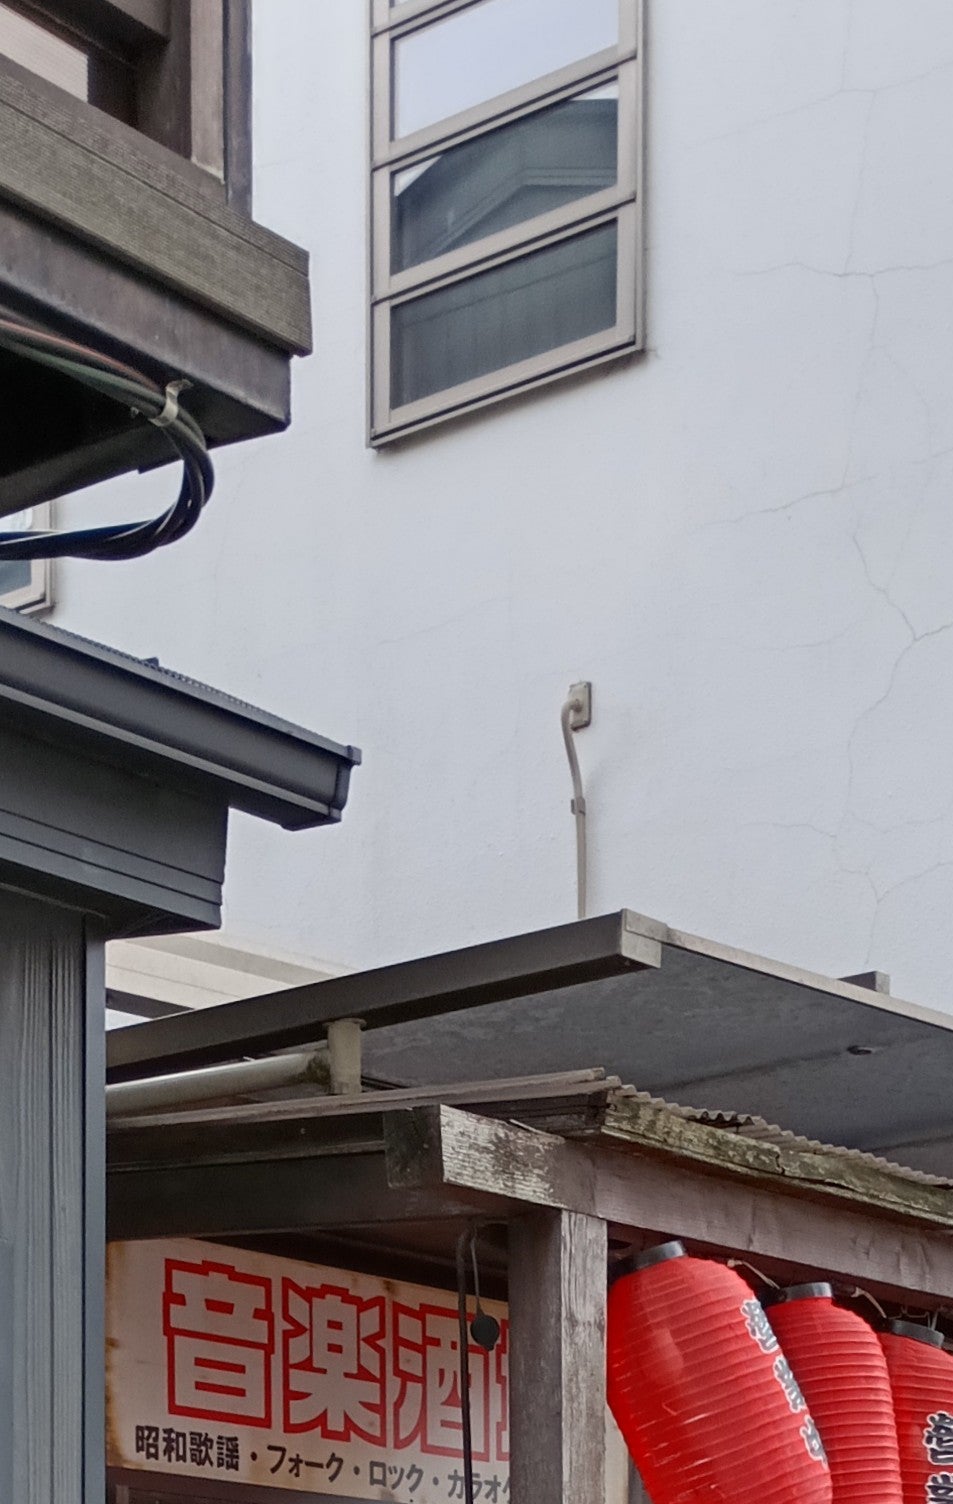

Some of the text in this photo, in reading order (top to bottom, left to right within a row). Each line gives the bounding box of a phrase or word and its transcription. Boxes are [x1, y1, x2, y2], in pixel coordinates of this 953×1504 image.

[163, 1257, 509, 1463] 音楽酒
[134, 1424, 510, 1504] 昭和歌謡・フォーク・ロック・カラオ
